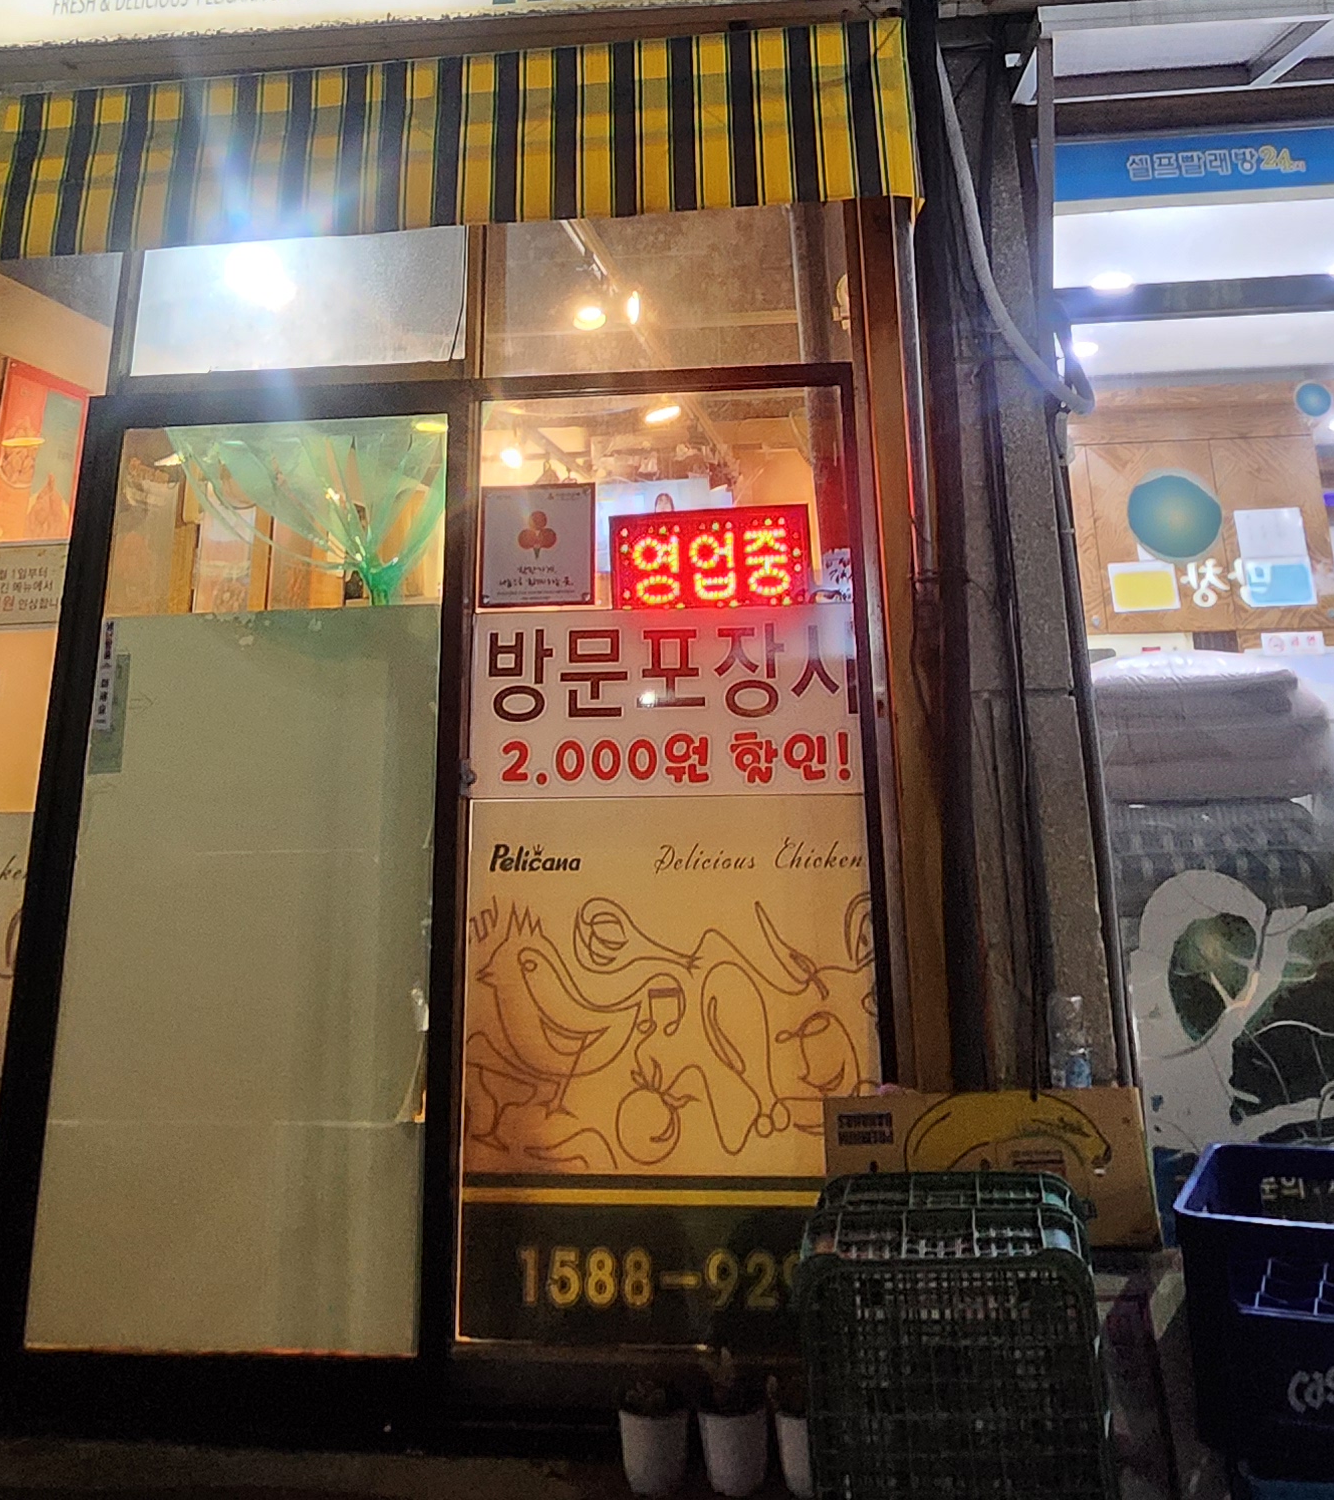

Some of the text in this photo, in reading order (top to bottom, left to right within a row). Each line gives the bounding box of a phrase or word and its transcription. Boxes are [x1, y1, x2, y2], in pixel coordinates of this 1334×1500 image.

[631, 529, 790, 605] 영업중
[488, 835, 864, 875] Pelicana Delicious Chicken
